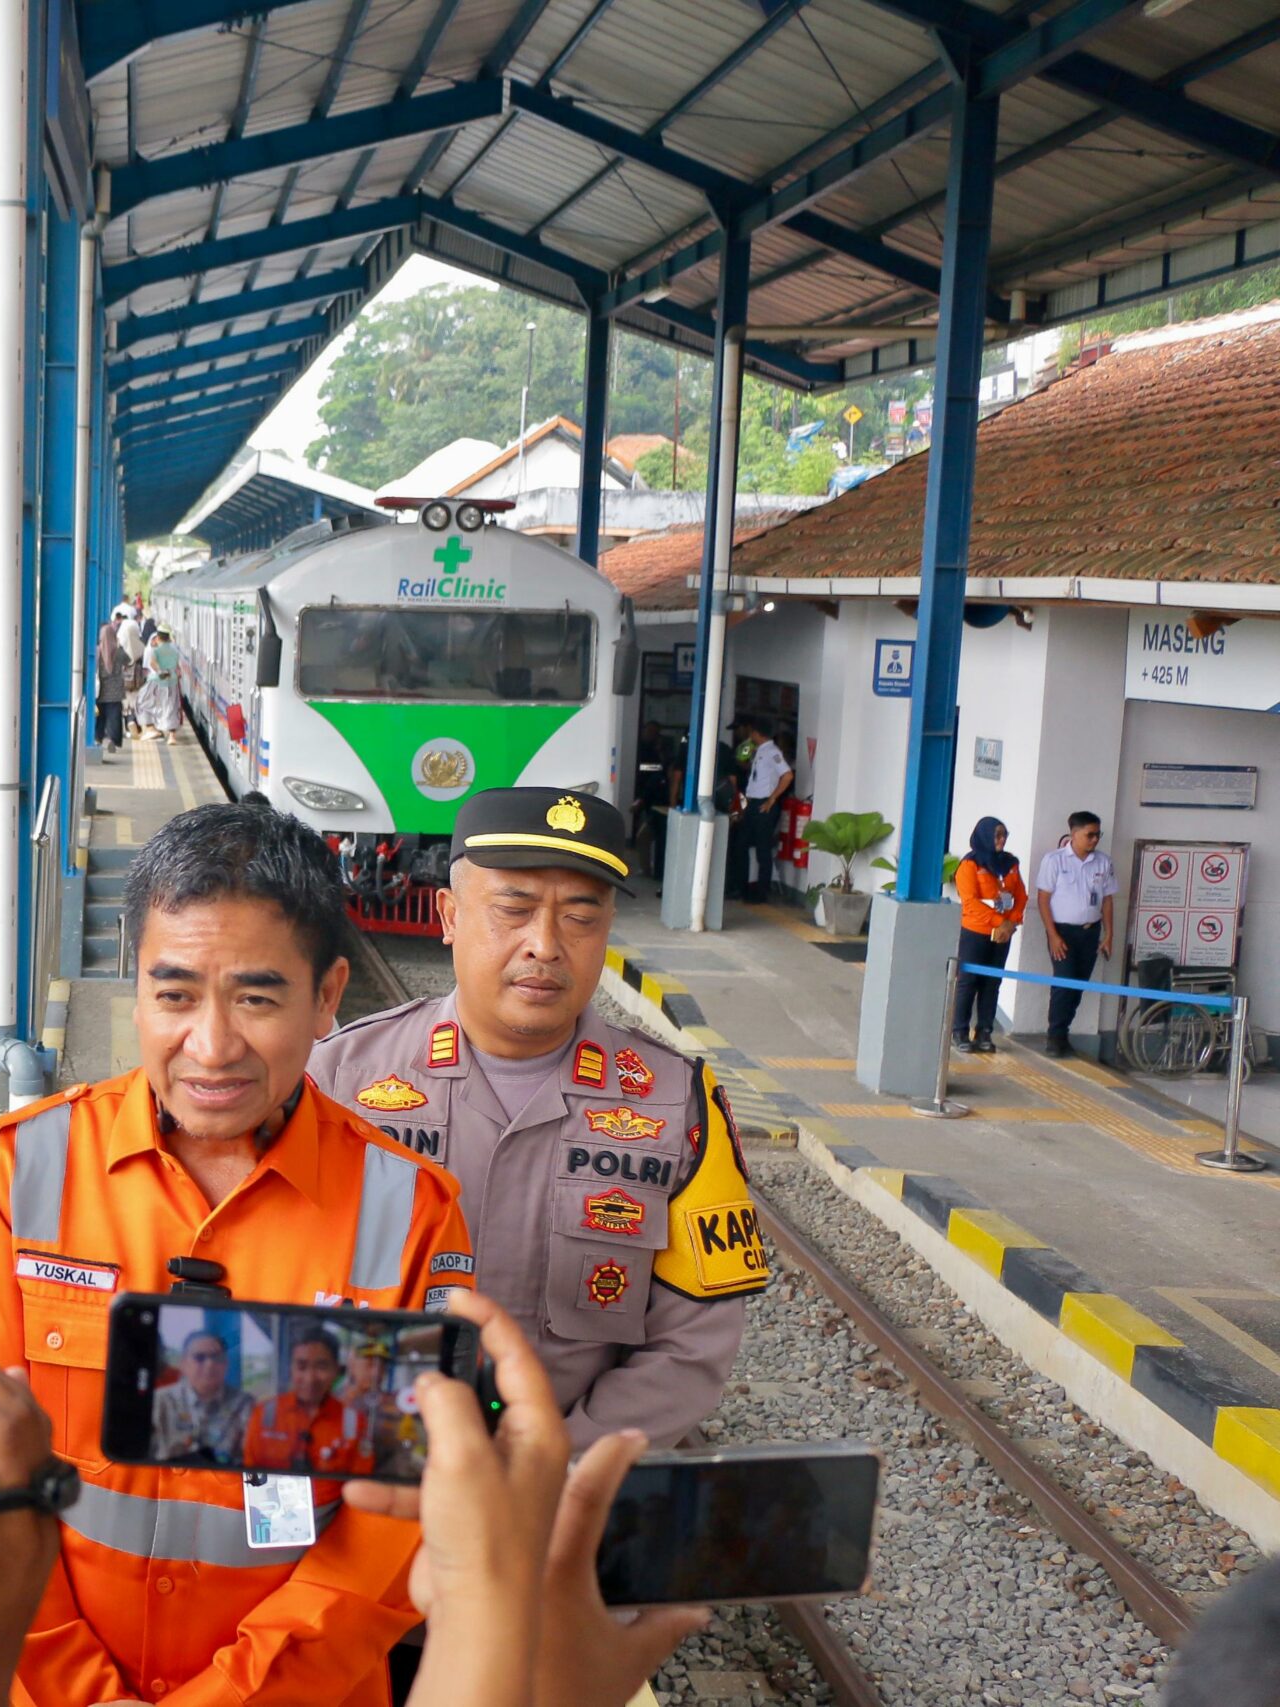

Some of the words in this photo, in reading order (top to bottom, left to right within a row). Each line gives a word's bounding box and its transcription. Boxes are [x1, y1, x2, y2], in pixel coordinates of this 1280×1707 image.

[398, 577, 507, 599] RailClinic
[1152, 665, 1173, 685] 425
[1176, 665, 1189, 686] M
[567, 1147, 672, 1187] POLRI
[432, 1255, 461, 1270] DAOP
[464, 1258, 469, 1270] 1
[35, 1262, 96, 1286] YUSKAL
